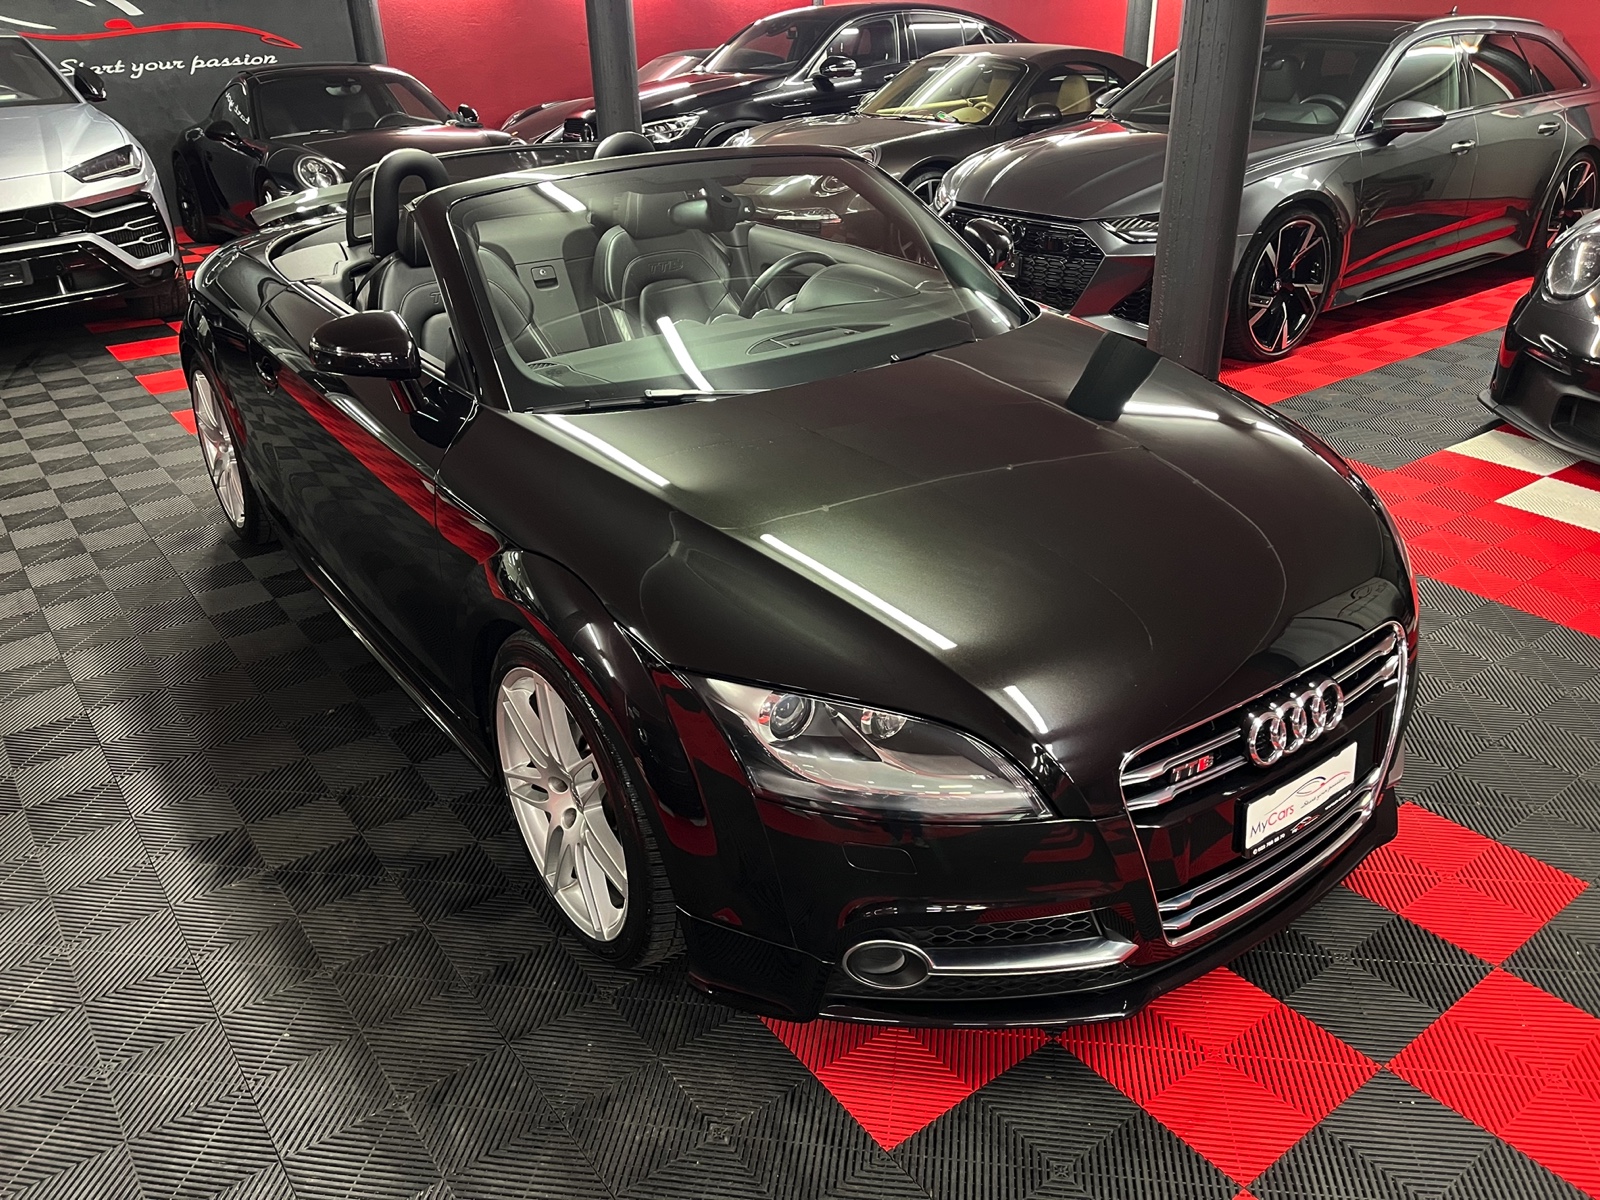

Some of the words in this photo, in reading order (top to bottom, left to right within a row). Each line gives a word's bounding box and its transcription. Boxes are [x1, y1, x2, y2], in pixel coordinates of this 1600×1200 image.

[59, 58, 126, 76] Sart
[130, 59, 186, 79] your
[190, 53, 278, 75] passion
[1250, 804, 1295, 838] MyCars
